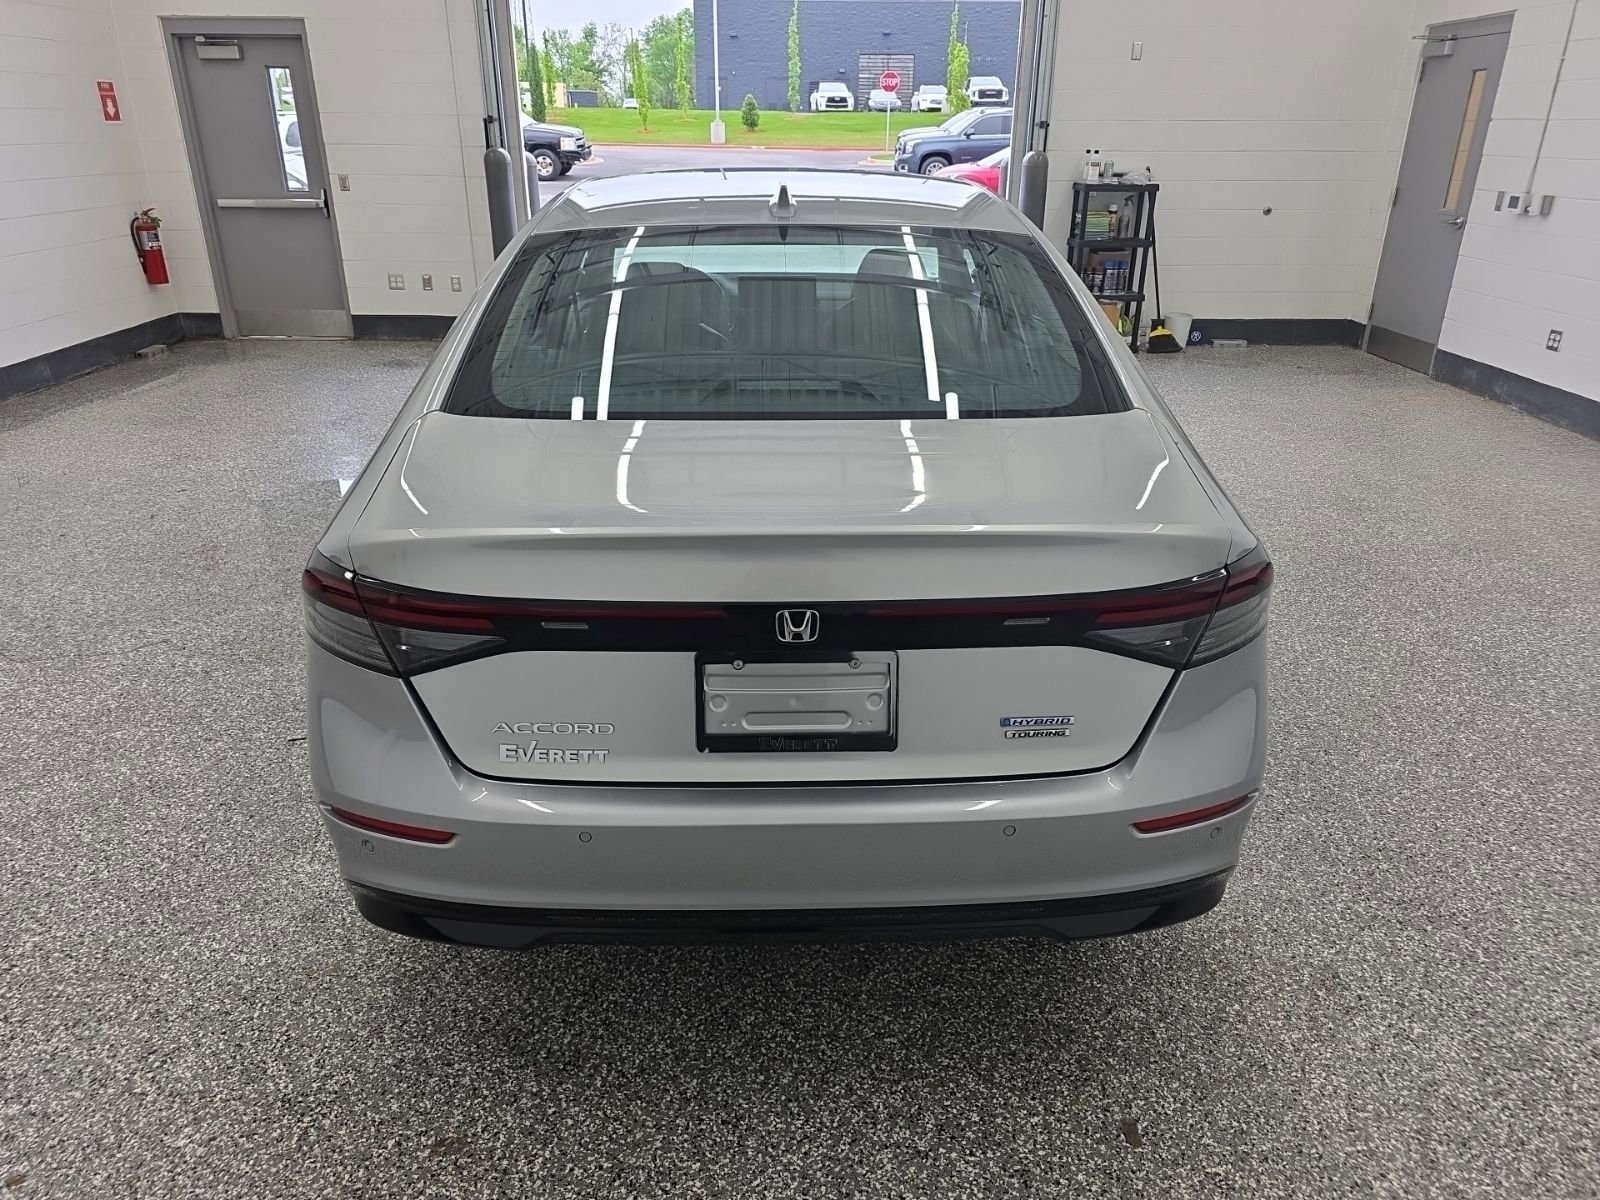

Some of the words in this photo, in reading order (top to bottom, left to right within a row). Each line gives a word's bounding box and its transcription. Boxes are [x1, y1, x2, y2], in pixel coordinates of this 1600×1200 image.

[881, 77, 898, 87] STOP
[1012, 718, 1071, 727] HYBRID
[492, 722, 615, 735] ACCORD
[1010, 730, 1067, 739] TOURING
